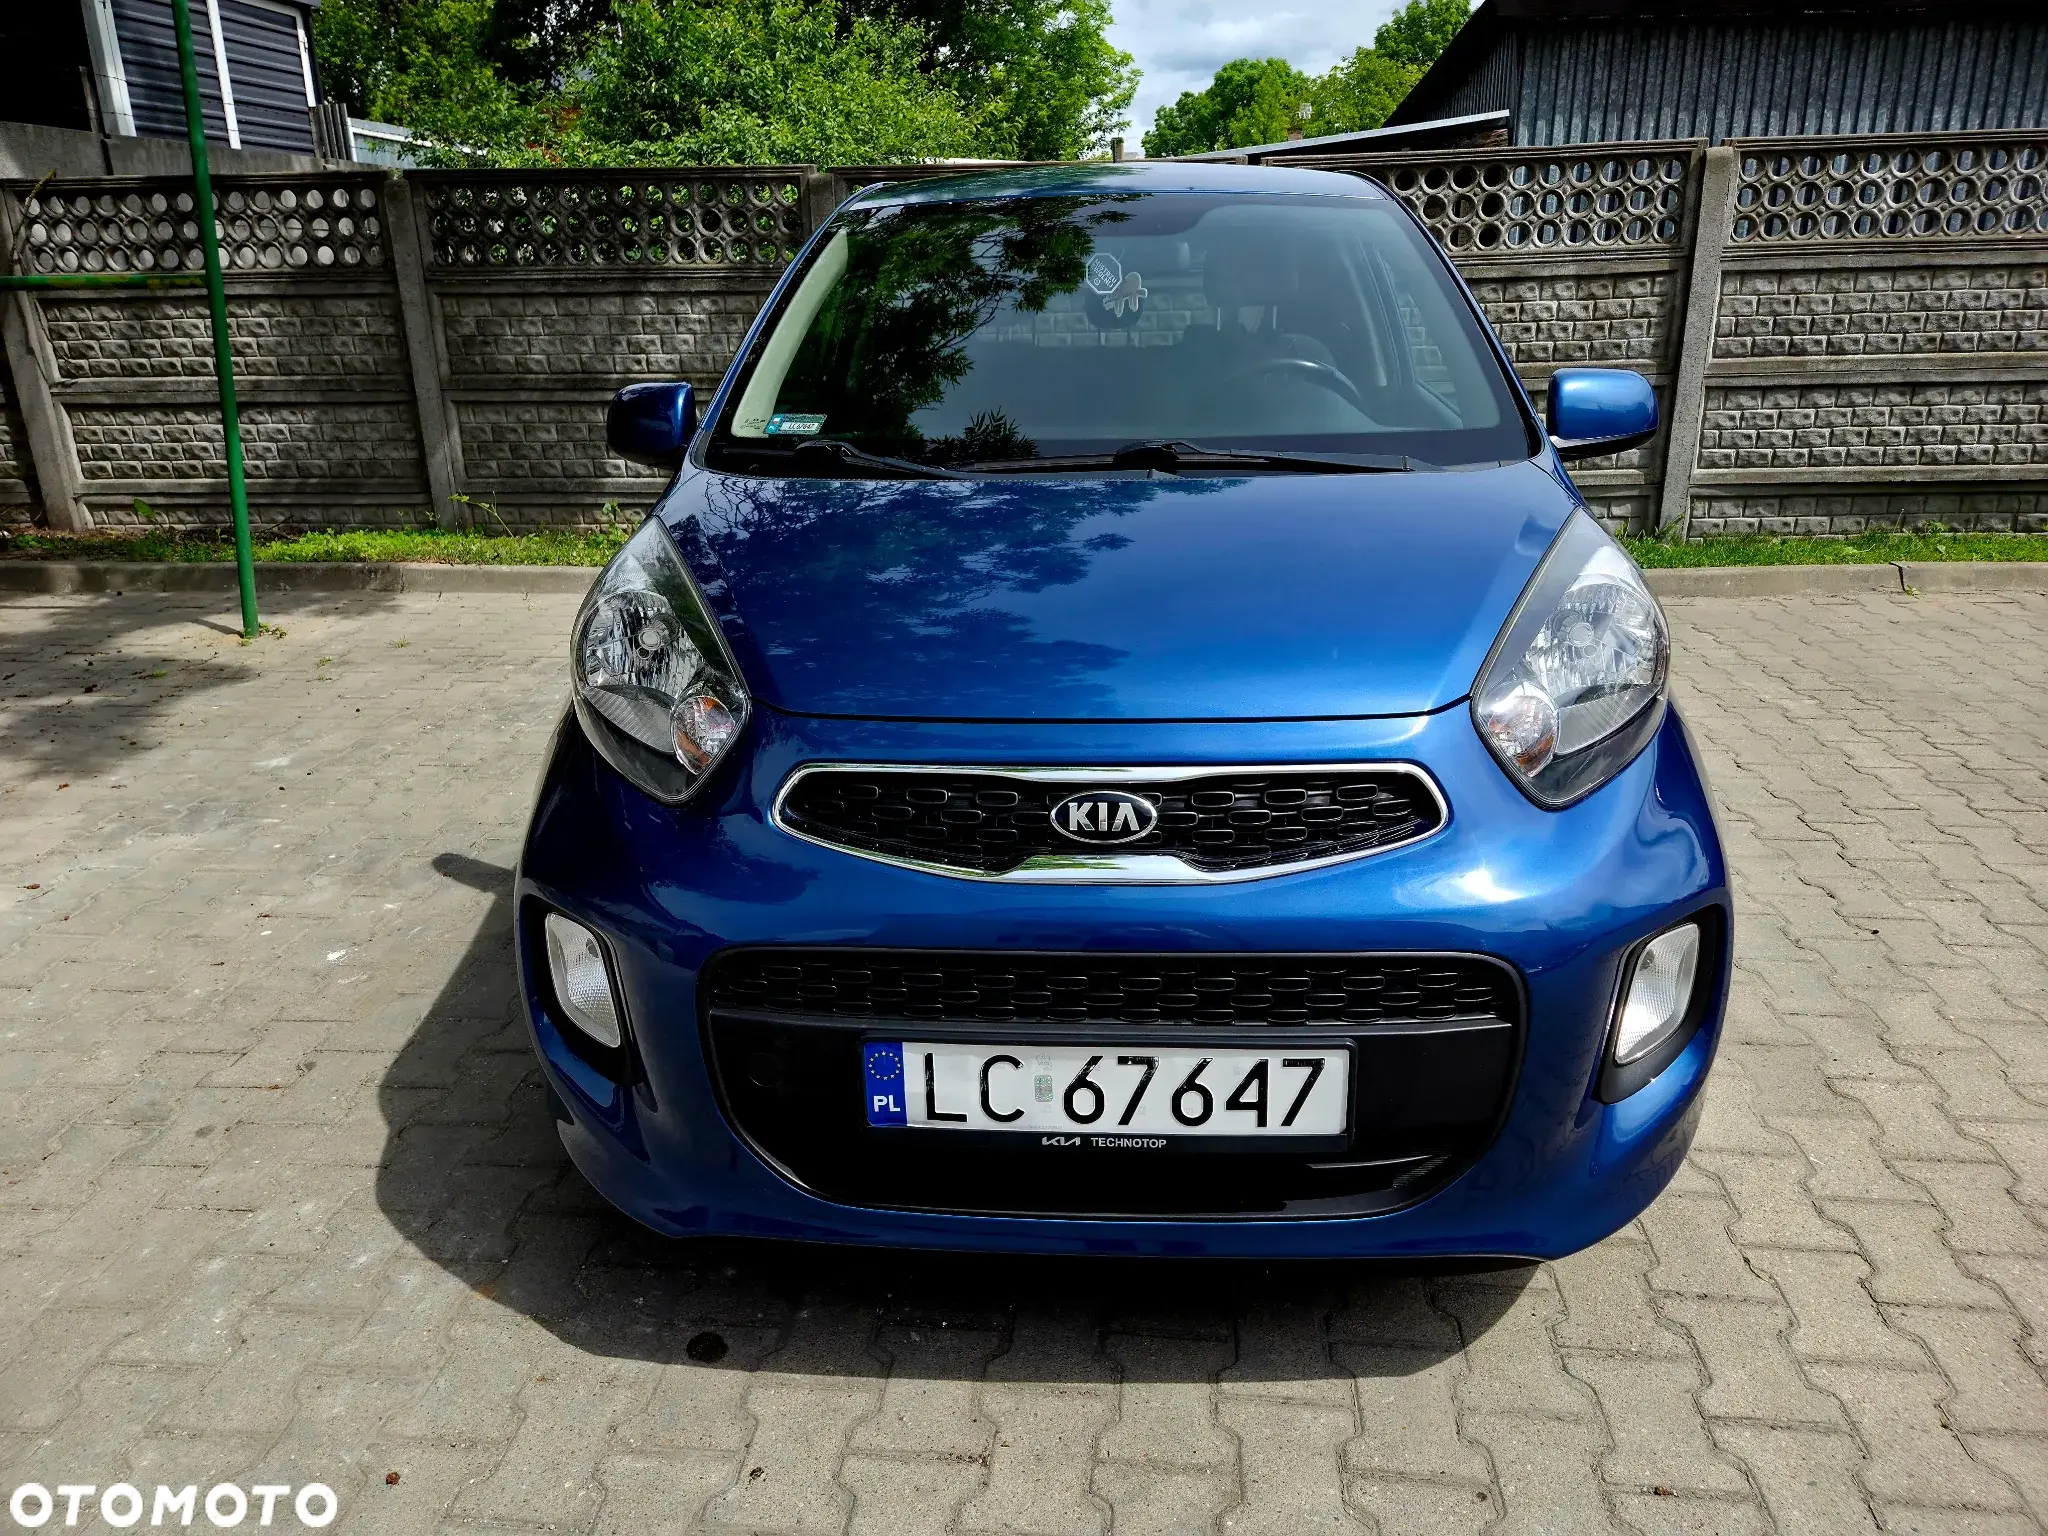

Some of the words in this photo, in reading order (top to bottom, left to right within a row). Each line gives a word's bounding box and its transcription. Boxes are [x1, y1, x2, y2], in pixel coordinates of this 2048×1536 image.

[1067, 802, 1140, 832] KIA
[923, 1052, 1025, 1123] LC
[1062, 1055, 1326, 1128] 67647
[873, 1095, 901, 1112] PL
[1091, 1137, 1167, 1148] TECHNOTOP
